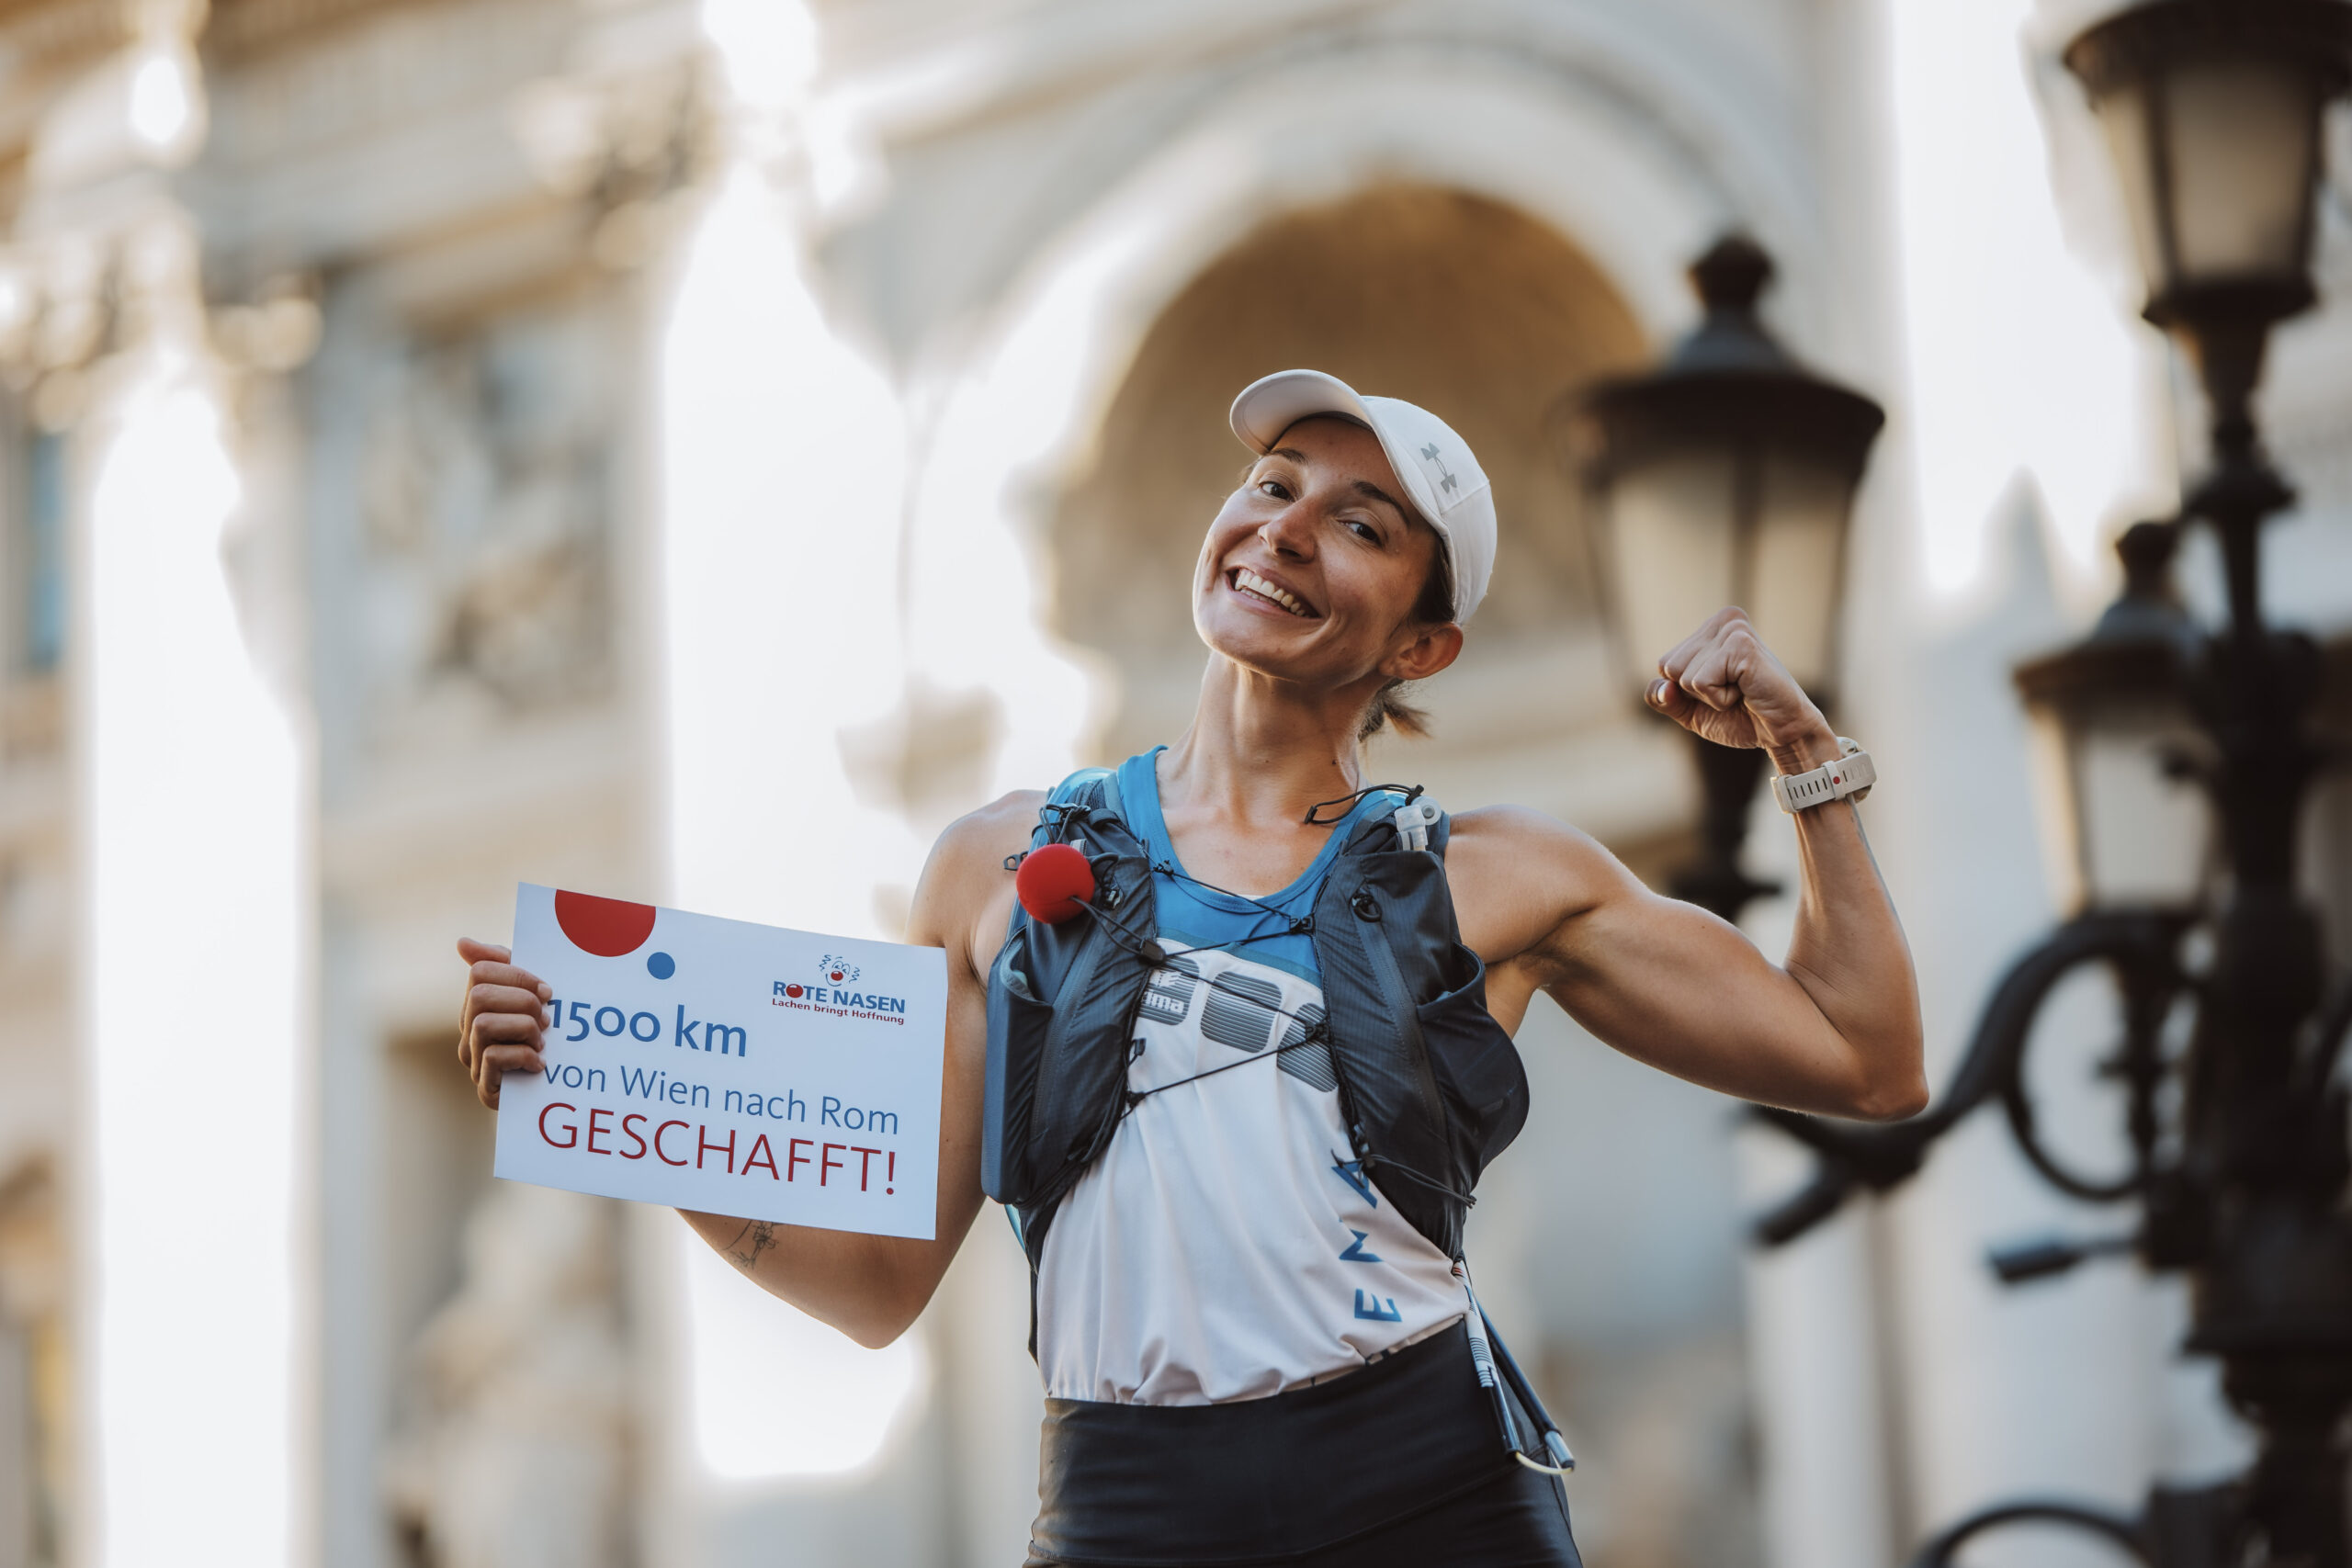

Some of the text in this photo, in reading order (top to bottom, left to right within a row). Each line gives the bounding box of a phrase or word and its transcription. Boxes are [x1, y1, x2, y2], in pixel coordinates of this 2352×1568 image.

[772, 998, 904, 1026] Lachen bringt Hoffnung
[773, 980, 906, 1014] ROTE NASEN
[548, 998, 748, 1057] 1500 km
[544, 1065, 899, 1134] von Wien nach Rom
[537, 1102, 897, 1196] GESCHAFFT!
